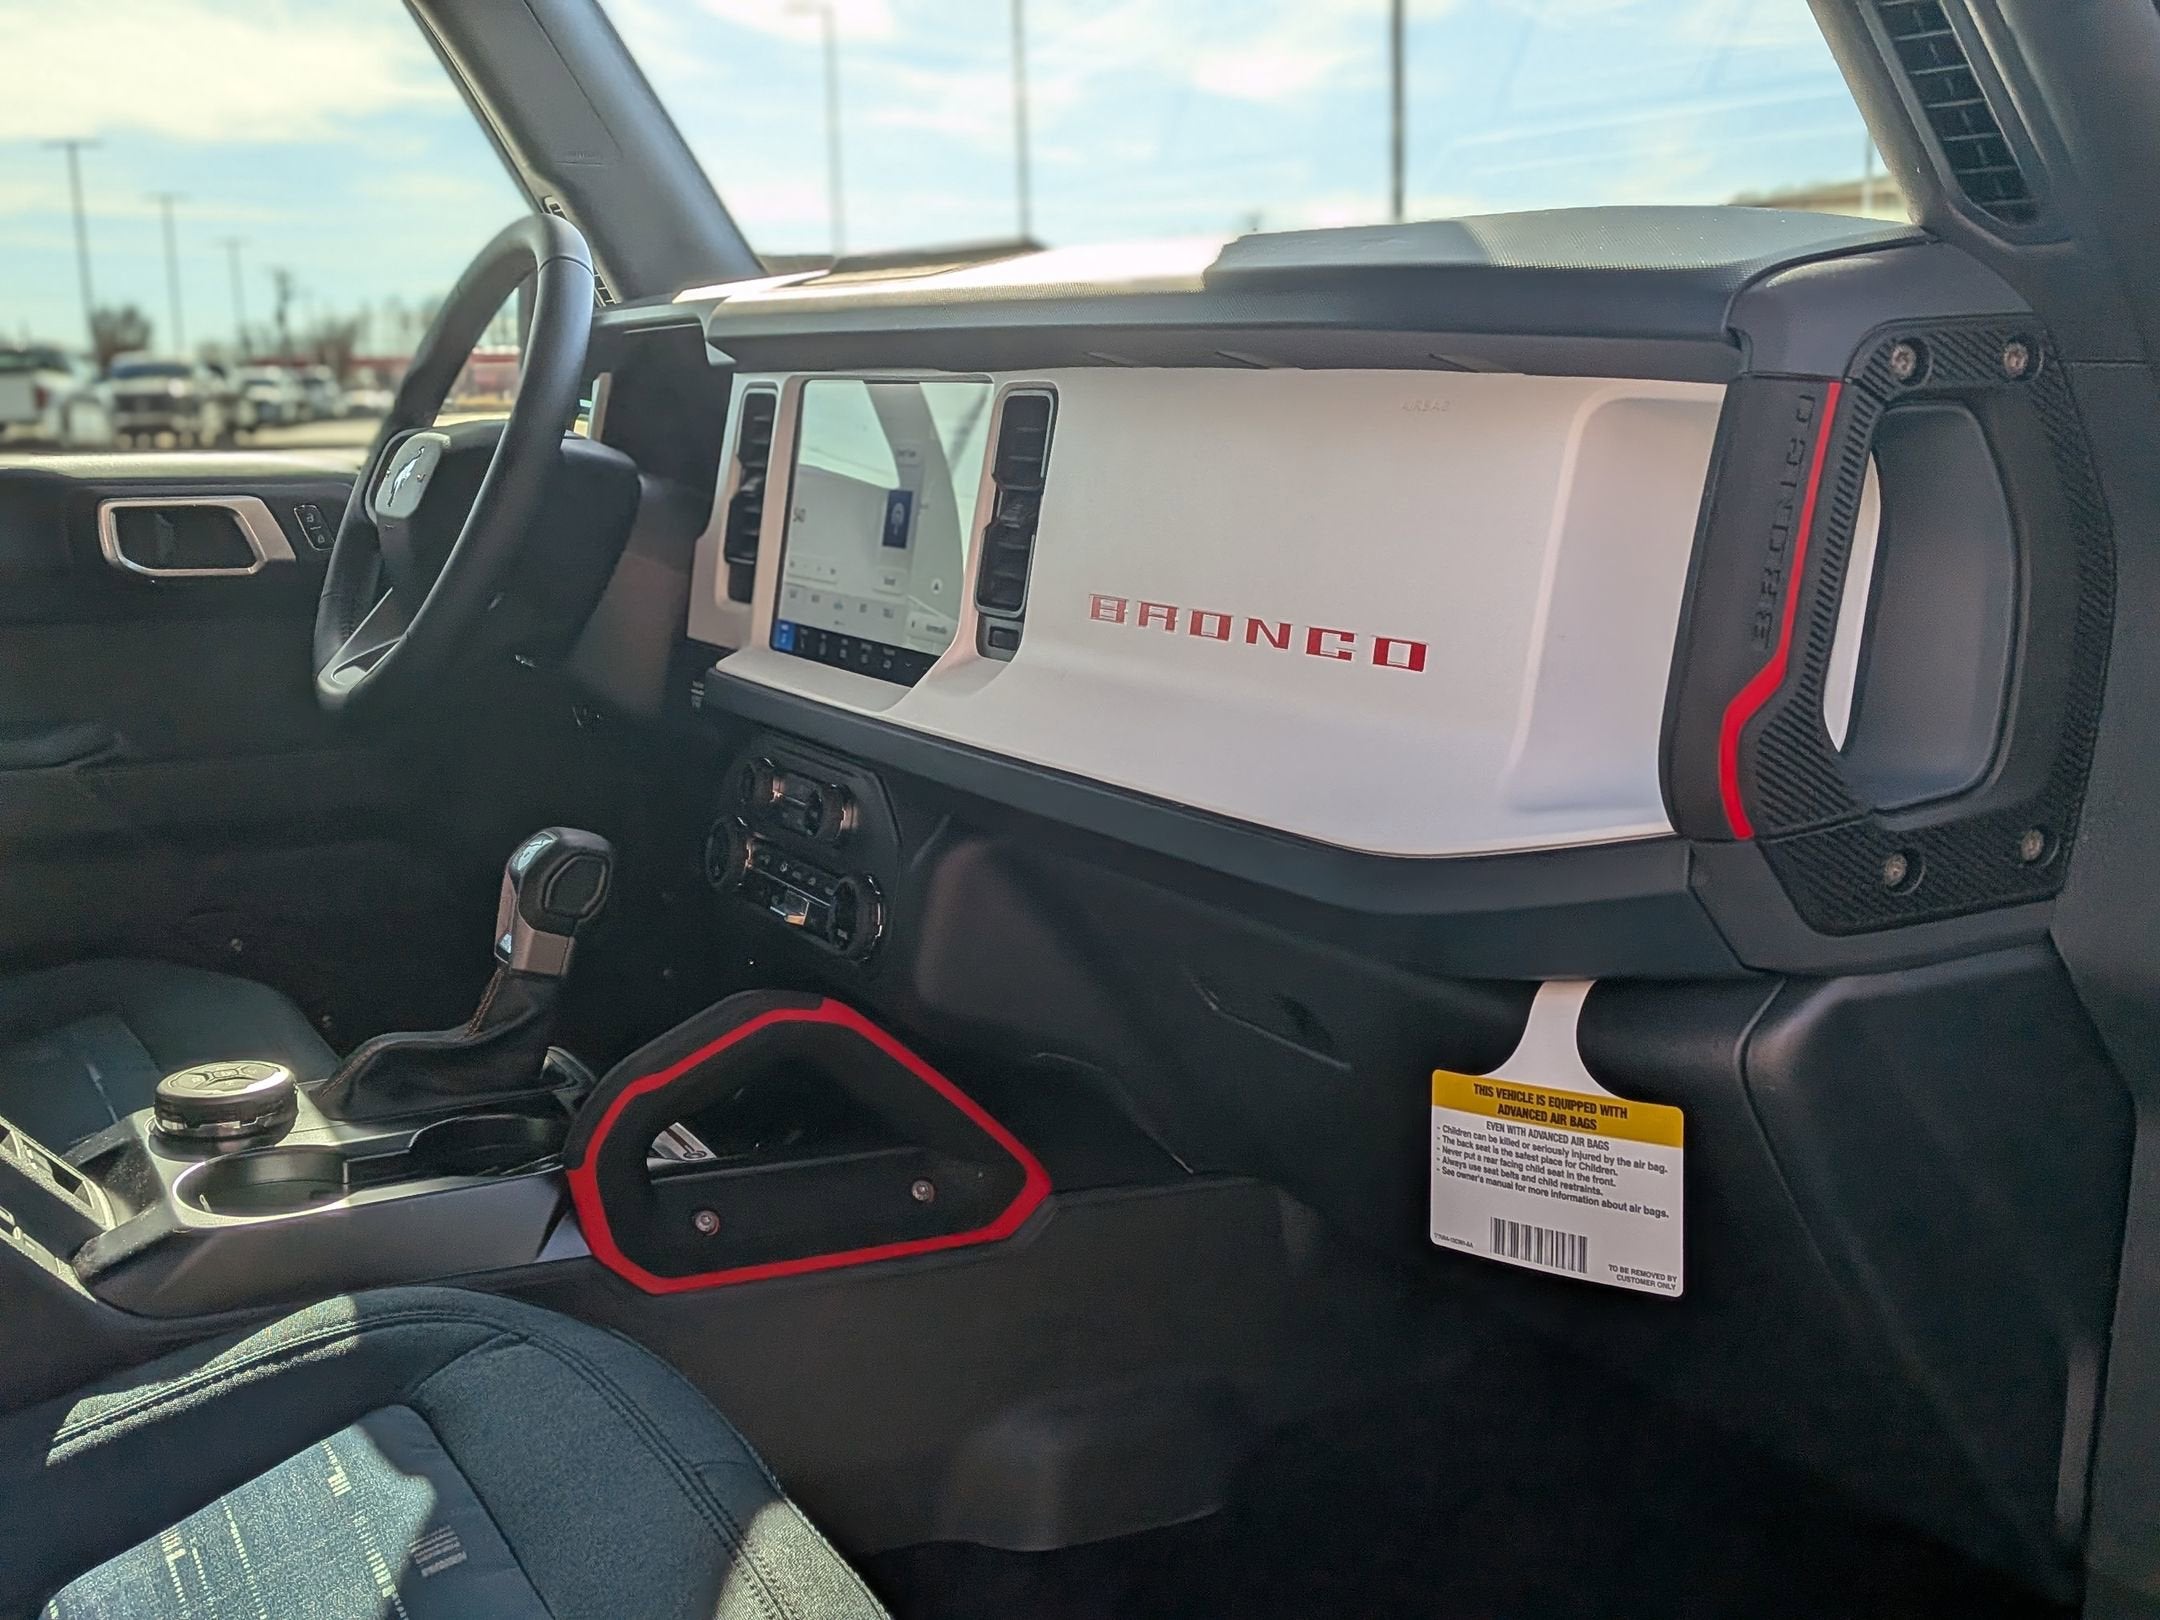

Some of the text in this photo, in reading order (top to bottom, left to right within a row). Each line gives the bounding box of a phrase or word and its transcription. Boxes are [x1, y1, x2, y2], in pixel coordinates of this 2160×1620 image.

[1754, 394, 1816, 649] BRONCO
[1088, 593, 1429, 672] BRONCO
[1473, 1083, 1627, 1119] THIS VEHICLE IS EQUIPPED WITH
[1497, 1103, 1597, 1130] ADVANCED AIR BAGS
[1442, 1124, 1667, 1174] Children can be killed or seriously injured by the air bag.
[1442, 1134, 1455, 1145] The
[1456, 1138, 1474, 1149] back
[1475, 1143, 1491, 1153] seat
[1492, 1144, 1499, 1154] is
[1500, 1147, 1513, 1157] the
[1514, 1151, 1539, 1162] safest
[1540, 1155, 1562, 1166] place
[1564, 1158, 1577, 1169] for
[1486, 1120, 1609, 1151] EVEN WITH ADVANCED AIR BAGS
[1441, 1155, 1467, 1170] Always
[1468, 1163, 1482, 1172] use
[1483, 1166, 1499, 1176] seat
[1500, 1168, 1519, 1180] belts
[1520, 1174, 1536, 1183] and
[1537, 1176, 1558, 1188] child
[1442, 1144, 1462, 1157] Never
[1463, 1151, 1476, 1160] put
[1483, 1155, 1498, 1164] rear
[1499, 1157, 1523, 1172] facing
[1525, 1163, 1545, 1174] child
[1546, 1168, 1564, 1178] seat
[1566, 1169, 1574, 1180] in
[1576, 1172, 1590, 1182] the
[1441, 1166, 1669, 1218] See owner's manual for more information about air bags.
[1608, 1263, 1677, 1282] TO BE REMOVED BY
[1616, 1274, 1676, 1290] CUSTOMER ONLY
